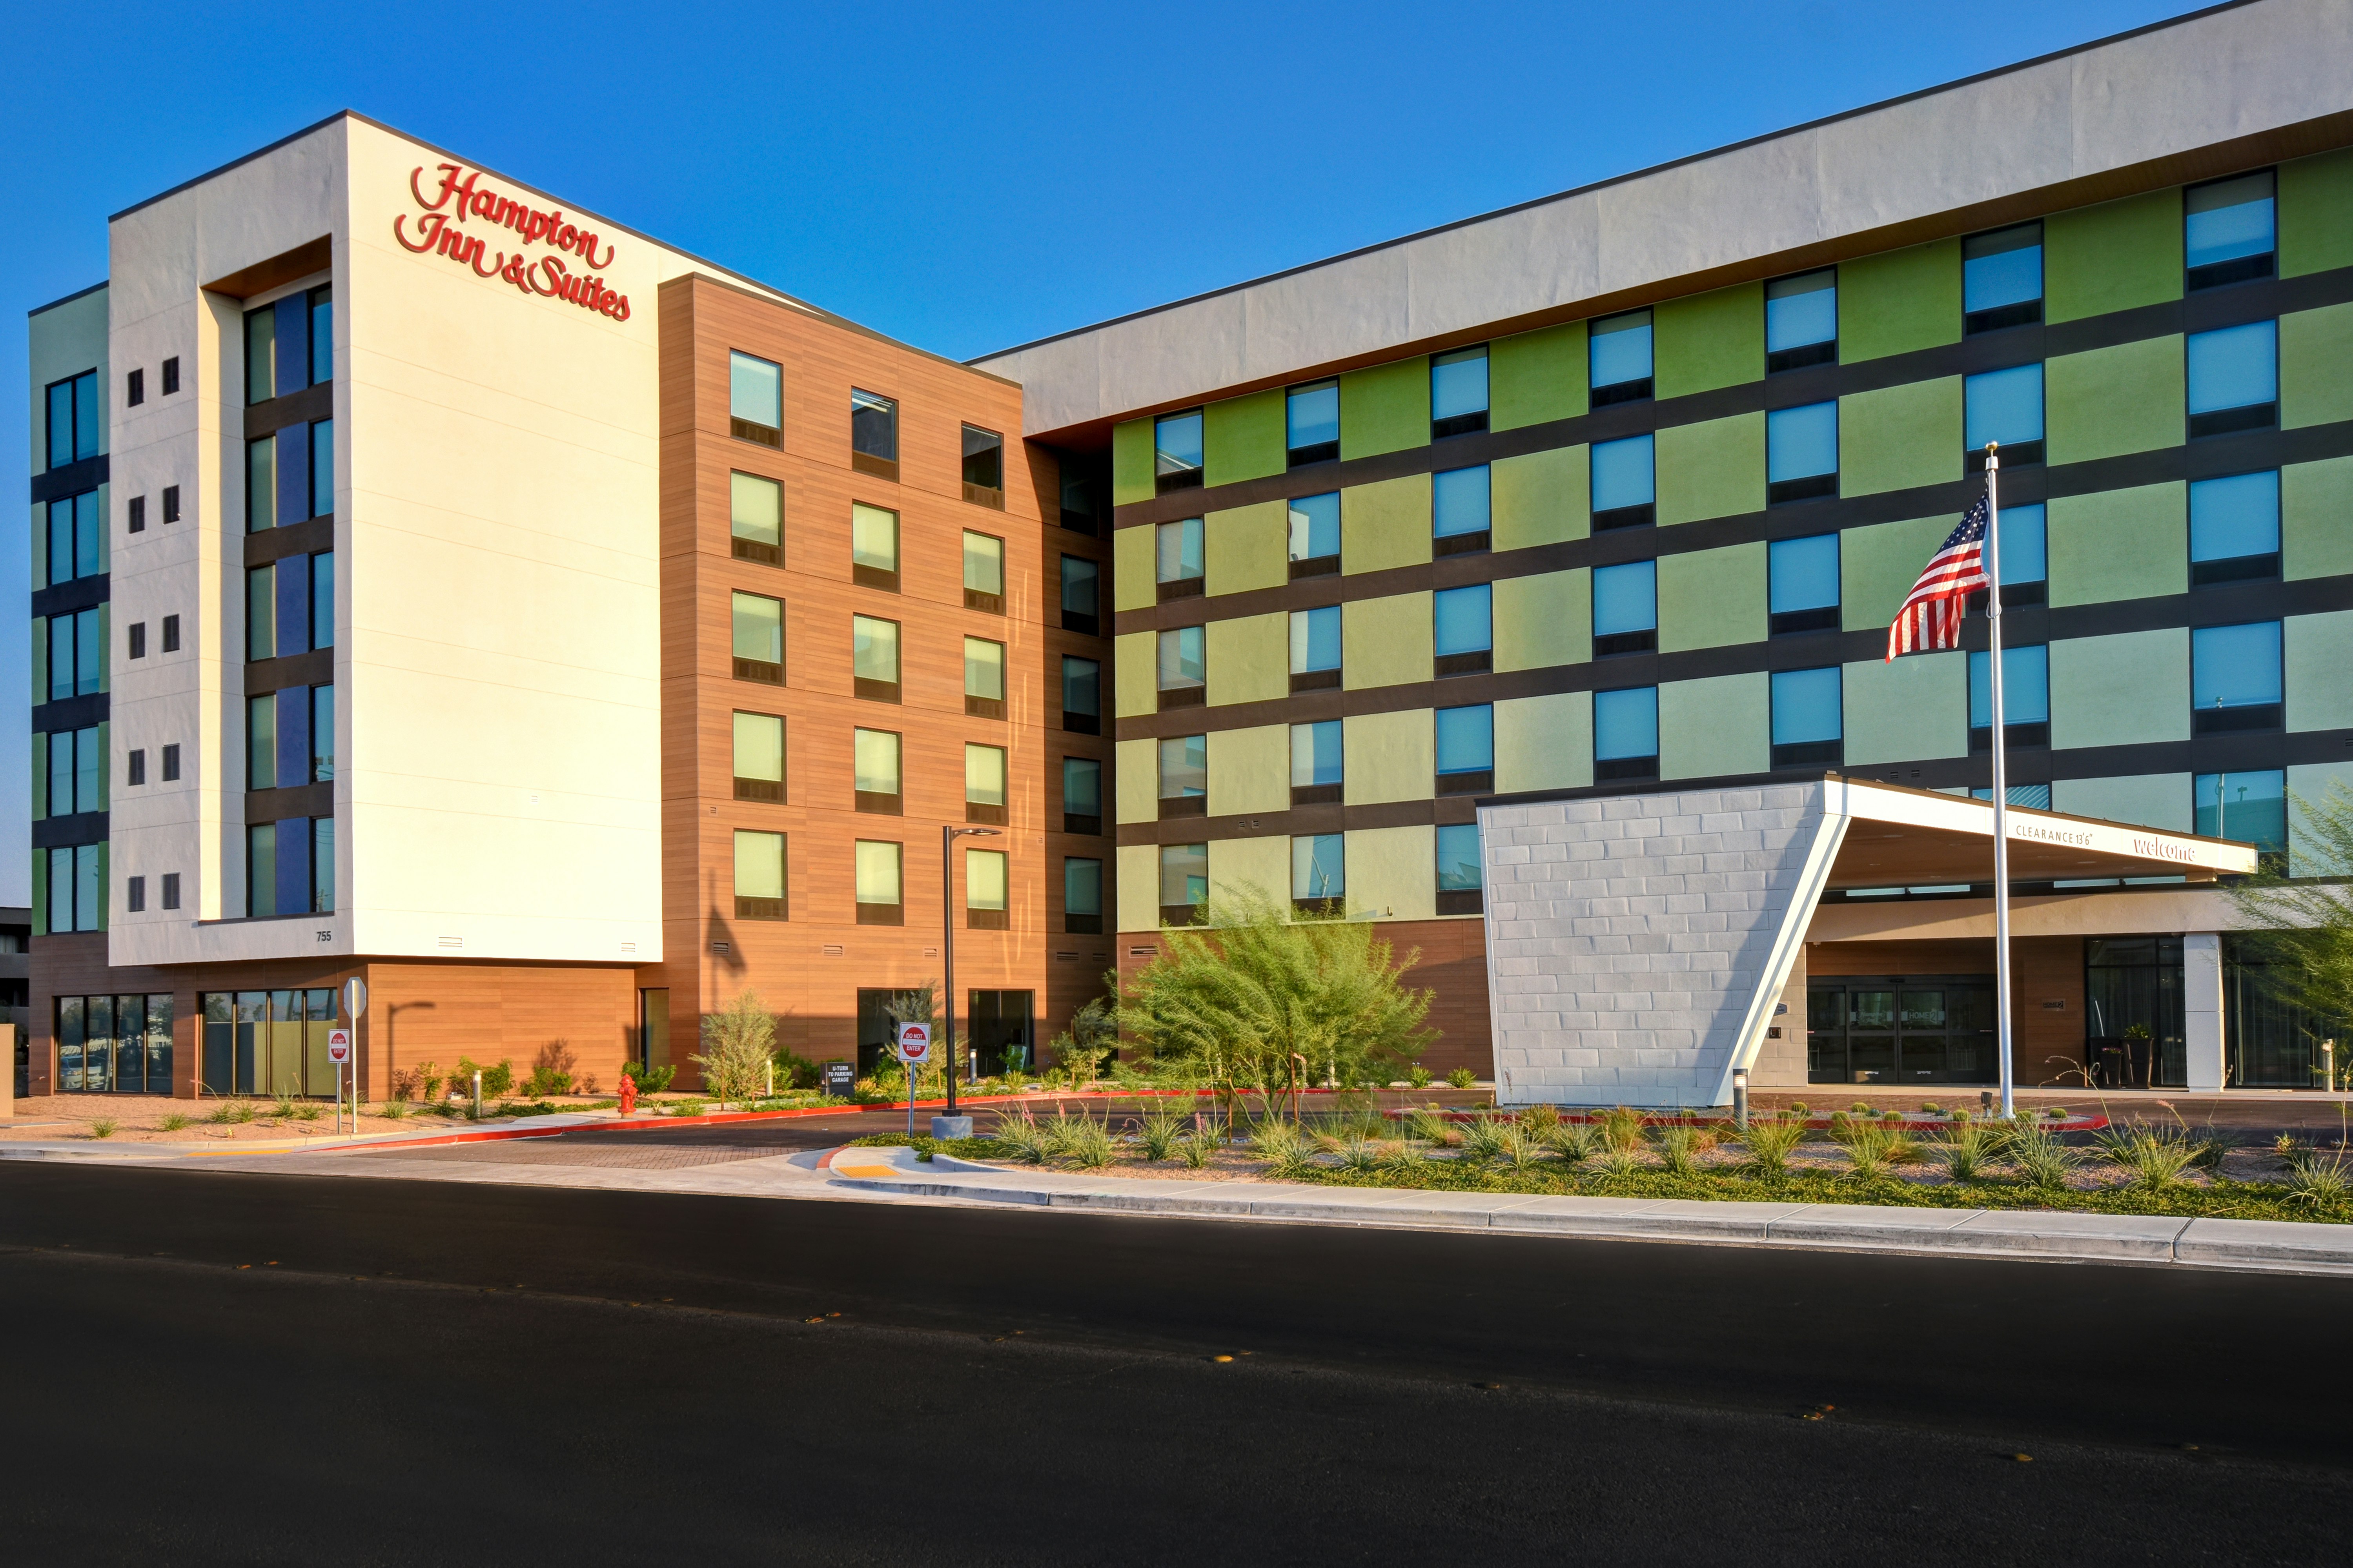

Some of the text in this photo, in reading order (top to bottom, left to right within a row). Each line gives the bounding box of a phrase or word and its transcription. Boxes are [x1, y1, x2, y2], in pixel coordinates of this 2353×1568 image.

[410, 163, 614, 270] Hampton
[393, 213, 630, 322] Inn & Suites
[2016, 825, 2073, 843] CLEARANCE
[2134, 836, 2196, 862] welcome
[317, 931, 331, 942] 755
